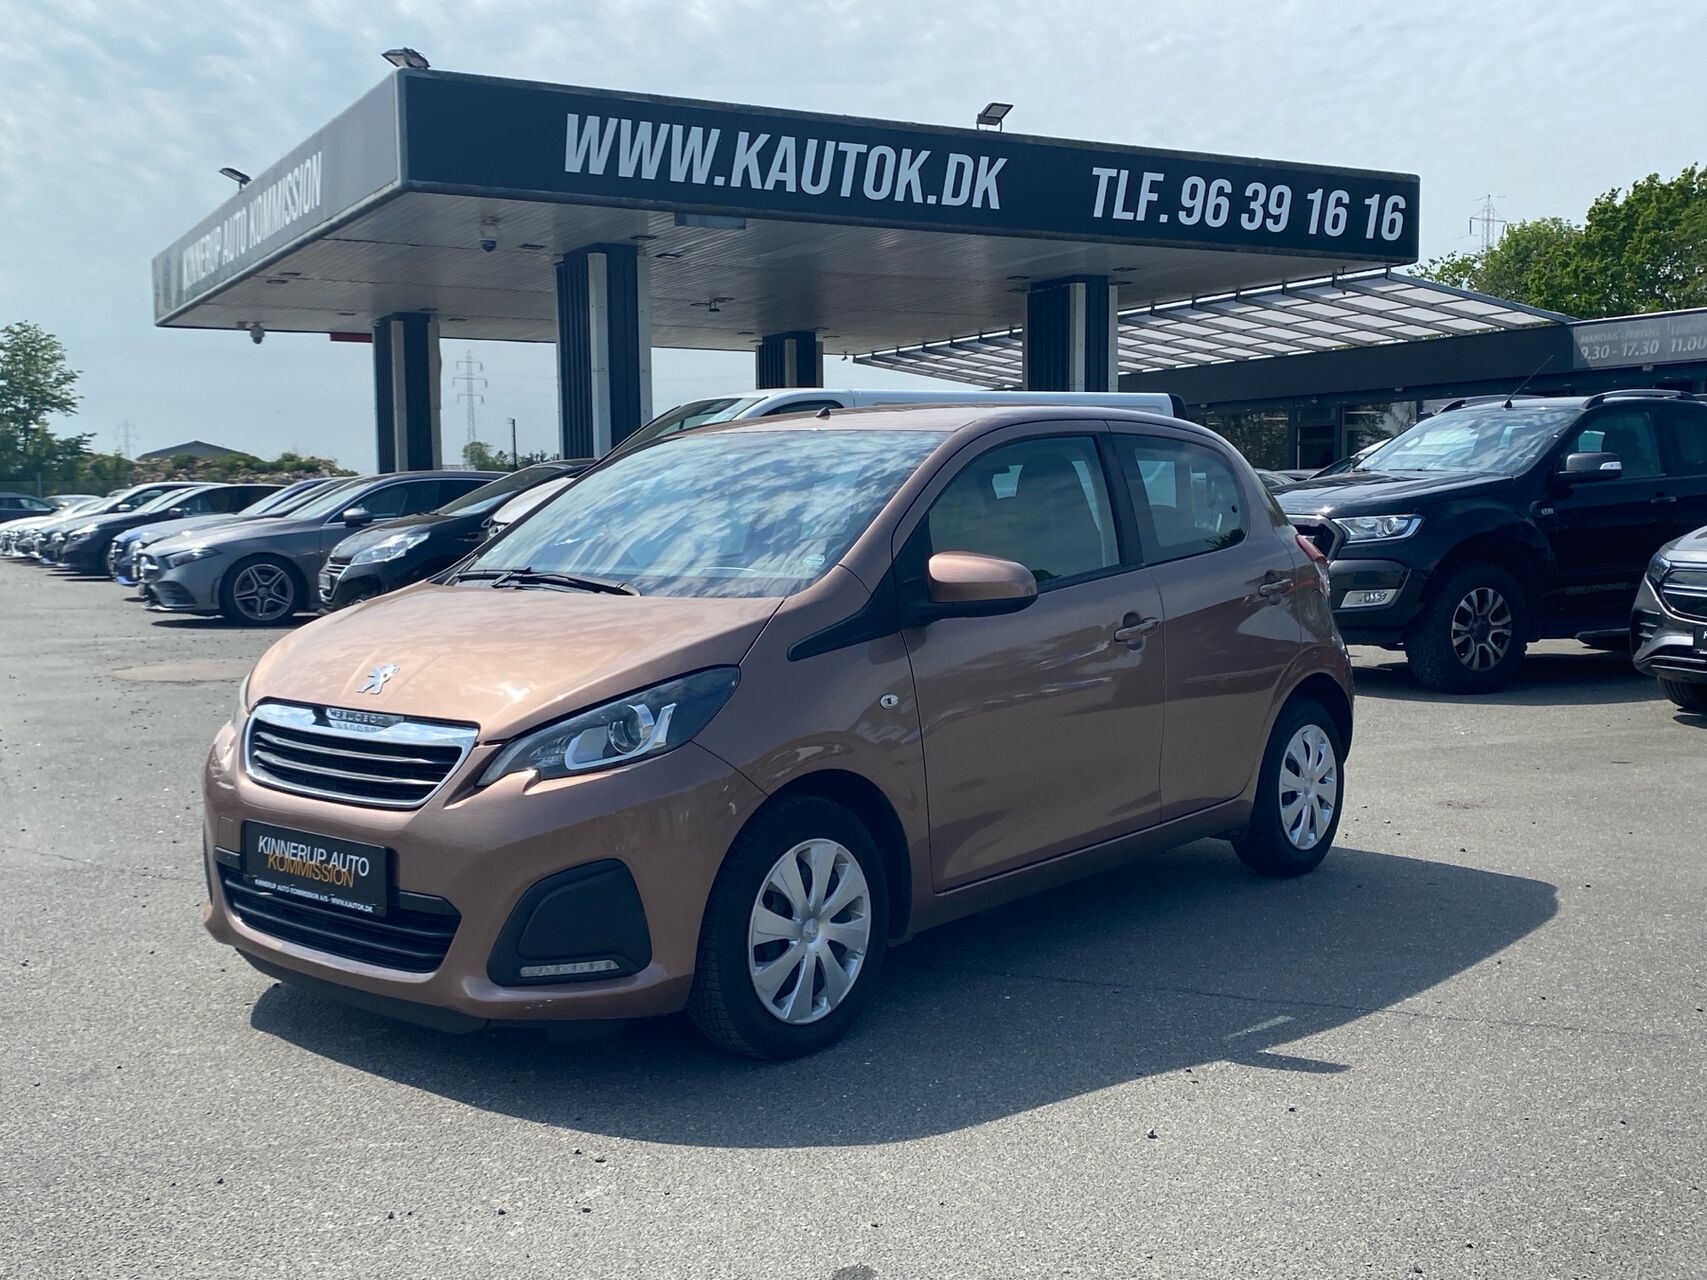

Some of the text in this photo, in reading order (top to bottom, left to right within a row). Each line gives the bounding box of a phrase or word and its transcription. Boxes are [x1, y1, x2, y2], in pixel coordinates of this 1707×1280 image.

[564, 113, 1008, 210] WWW.KAUTOK.DK
[222, 206, 247, 266] AUTO
[249, 151, 322, 249] KOMMISSION
[1092, 166, 1407, 241] TLF. 96 39 16 16
[1581, 344, 1610, 360] 9.30
[1623, 340, 1660, 357] 17.30
[258, 835, 370, 877] KINNERUP AUTO
[267, 854, 355, 888] KOMMISSION
